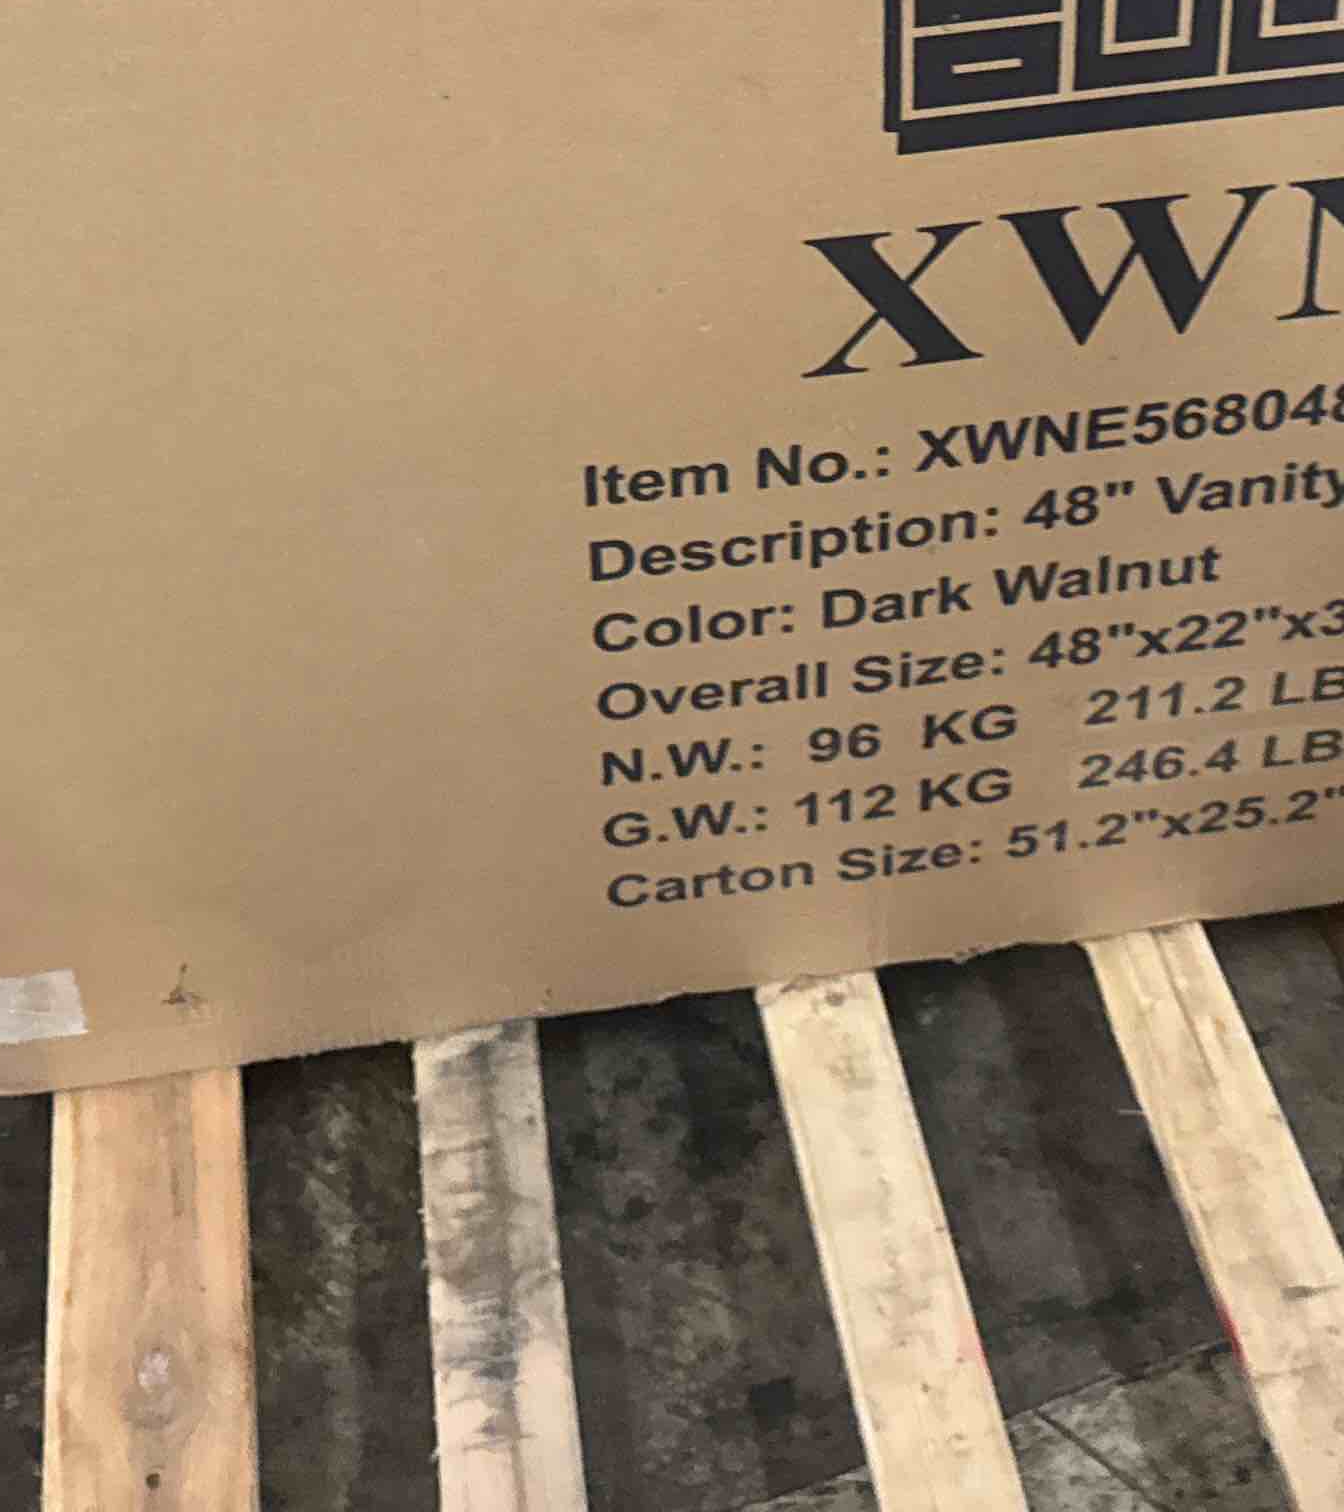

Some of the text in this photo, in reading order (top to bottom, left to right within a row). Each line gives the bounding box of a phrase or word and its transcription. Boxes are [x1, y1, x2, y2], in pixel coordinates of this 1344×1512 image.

[583, 462, 729, 508] Item
[757, 443, 890, 490] No.:
[589, 506, 999, 582] Description:
[1022, 480, 1135, 530] 48"
[593, 544, 1223, 653] Color: Dark Walnut
[597, 661, 829, 721] Overall
[852, 646, 1005, 694] Size:
[601, 736, 765, 786] N.W.:
[808, 721, 882, 764] 96
[920, 702, 1019, 749] KG
[1083, 674, 1247, 726] 211.2
[602, 799, 769, 849] G.W.:
[794, 783, 897, 828] 112
[918, 766, 1014, 812] KG
[1077, 738, 1240, 789] 246.4
[606, 859, 814, 909] Carton
[837, 838, 983, 883] Size:
